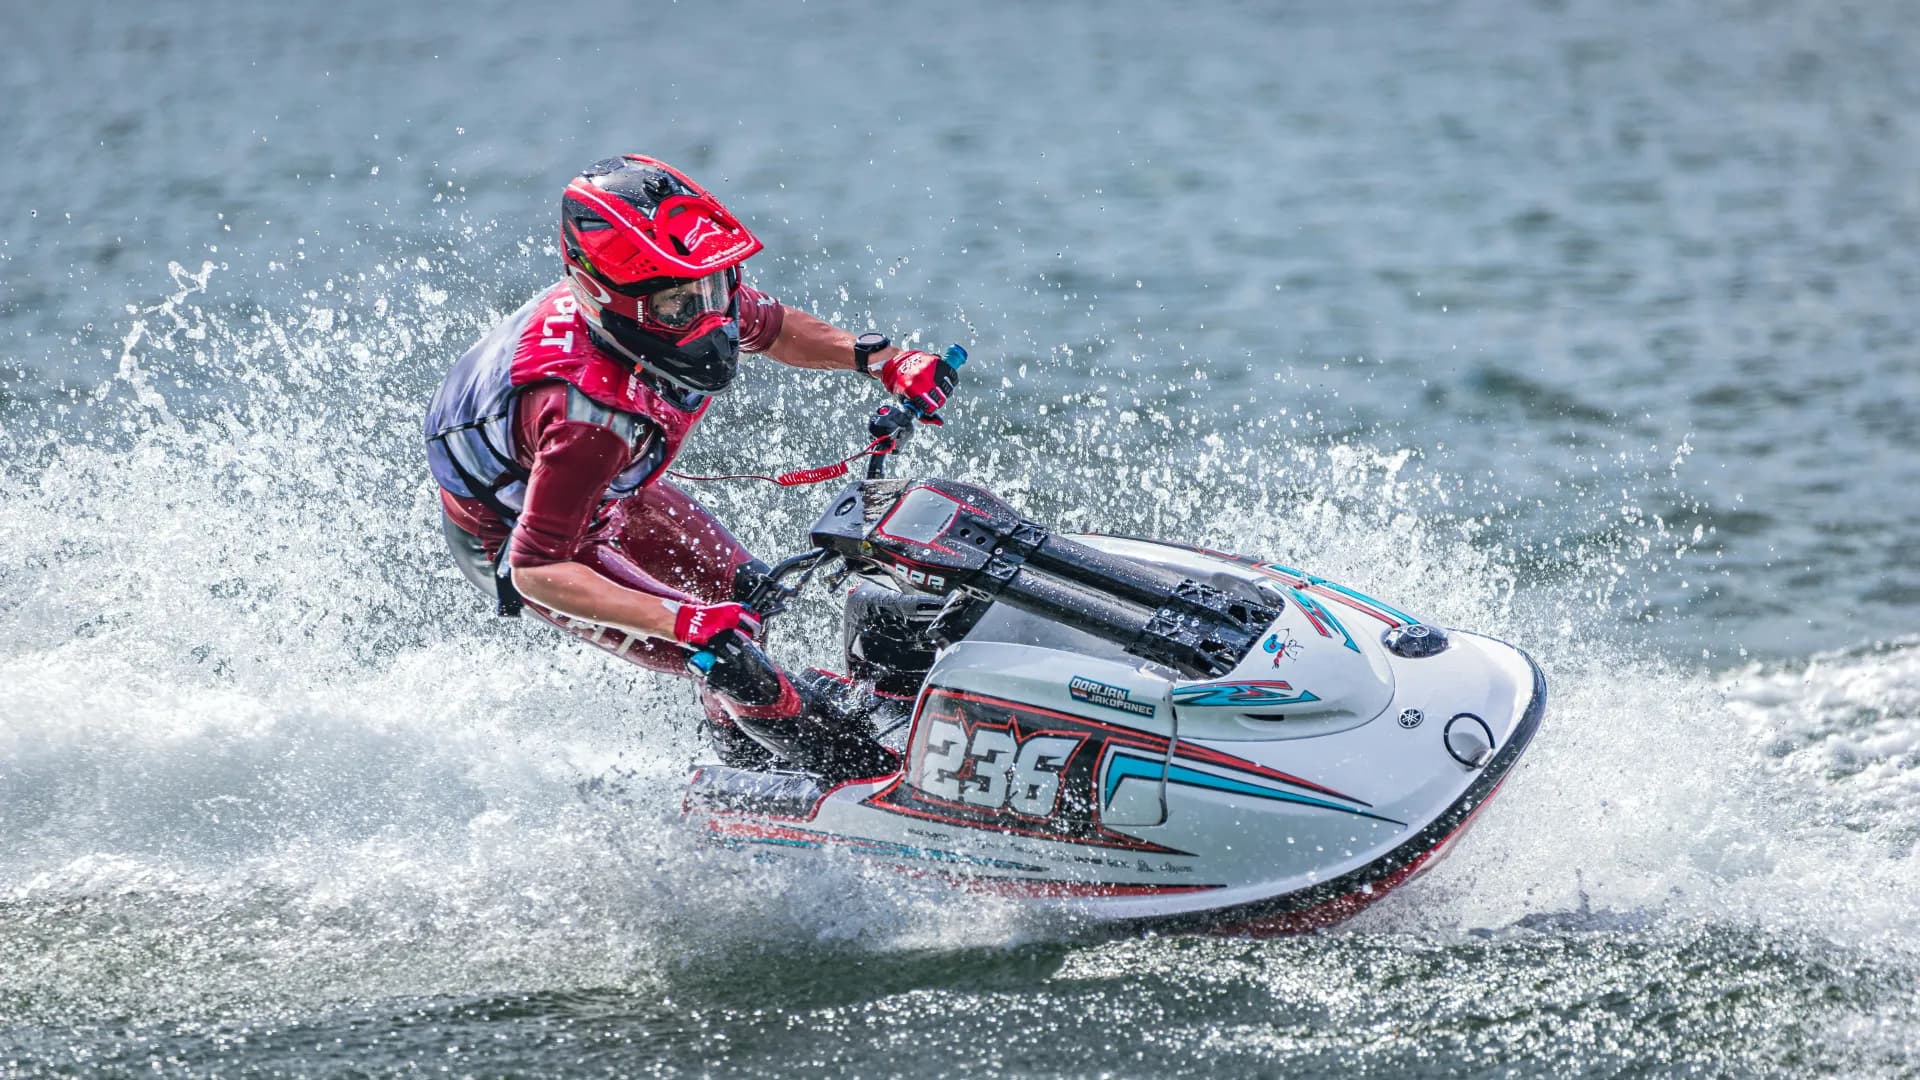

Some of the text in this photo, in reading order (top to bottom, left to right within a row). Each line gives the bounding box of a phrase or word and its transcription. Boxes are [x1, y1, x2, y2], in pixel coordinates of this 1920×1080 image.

[1071, 678, 1127, 700] DORIJAN
[1088, 694, 1153, 715] JAKOPANEC
[920, 719, 1081, 817] 236
